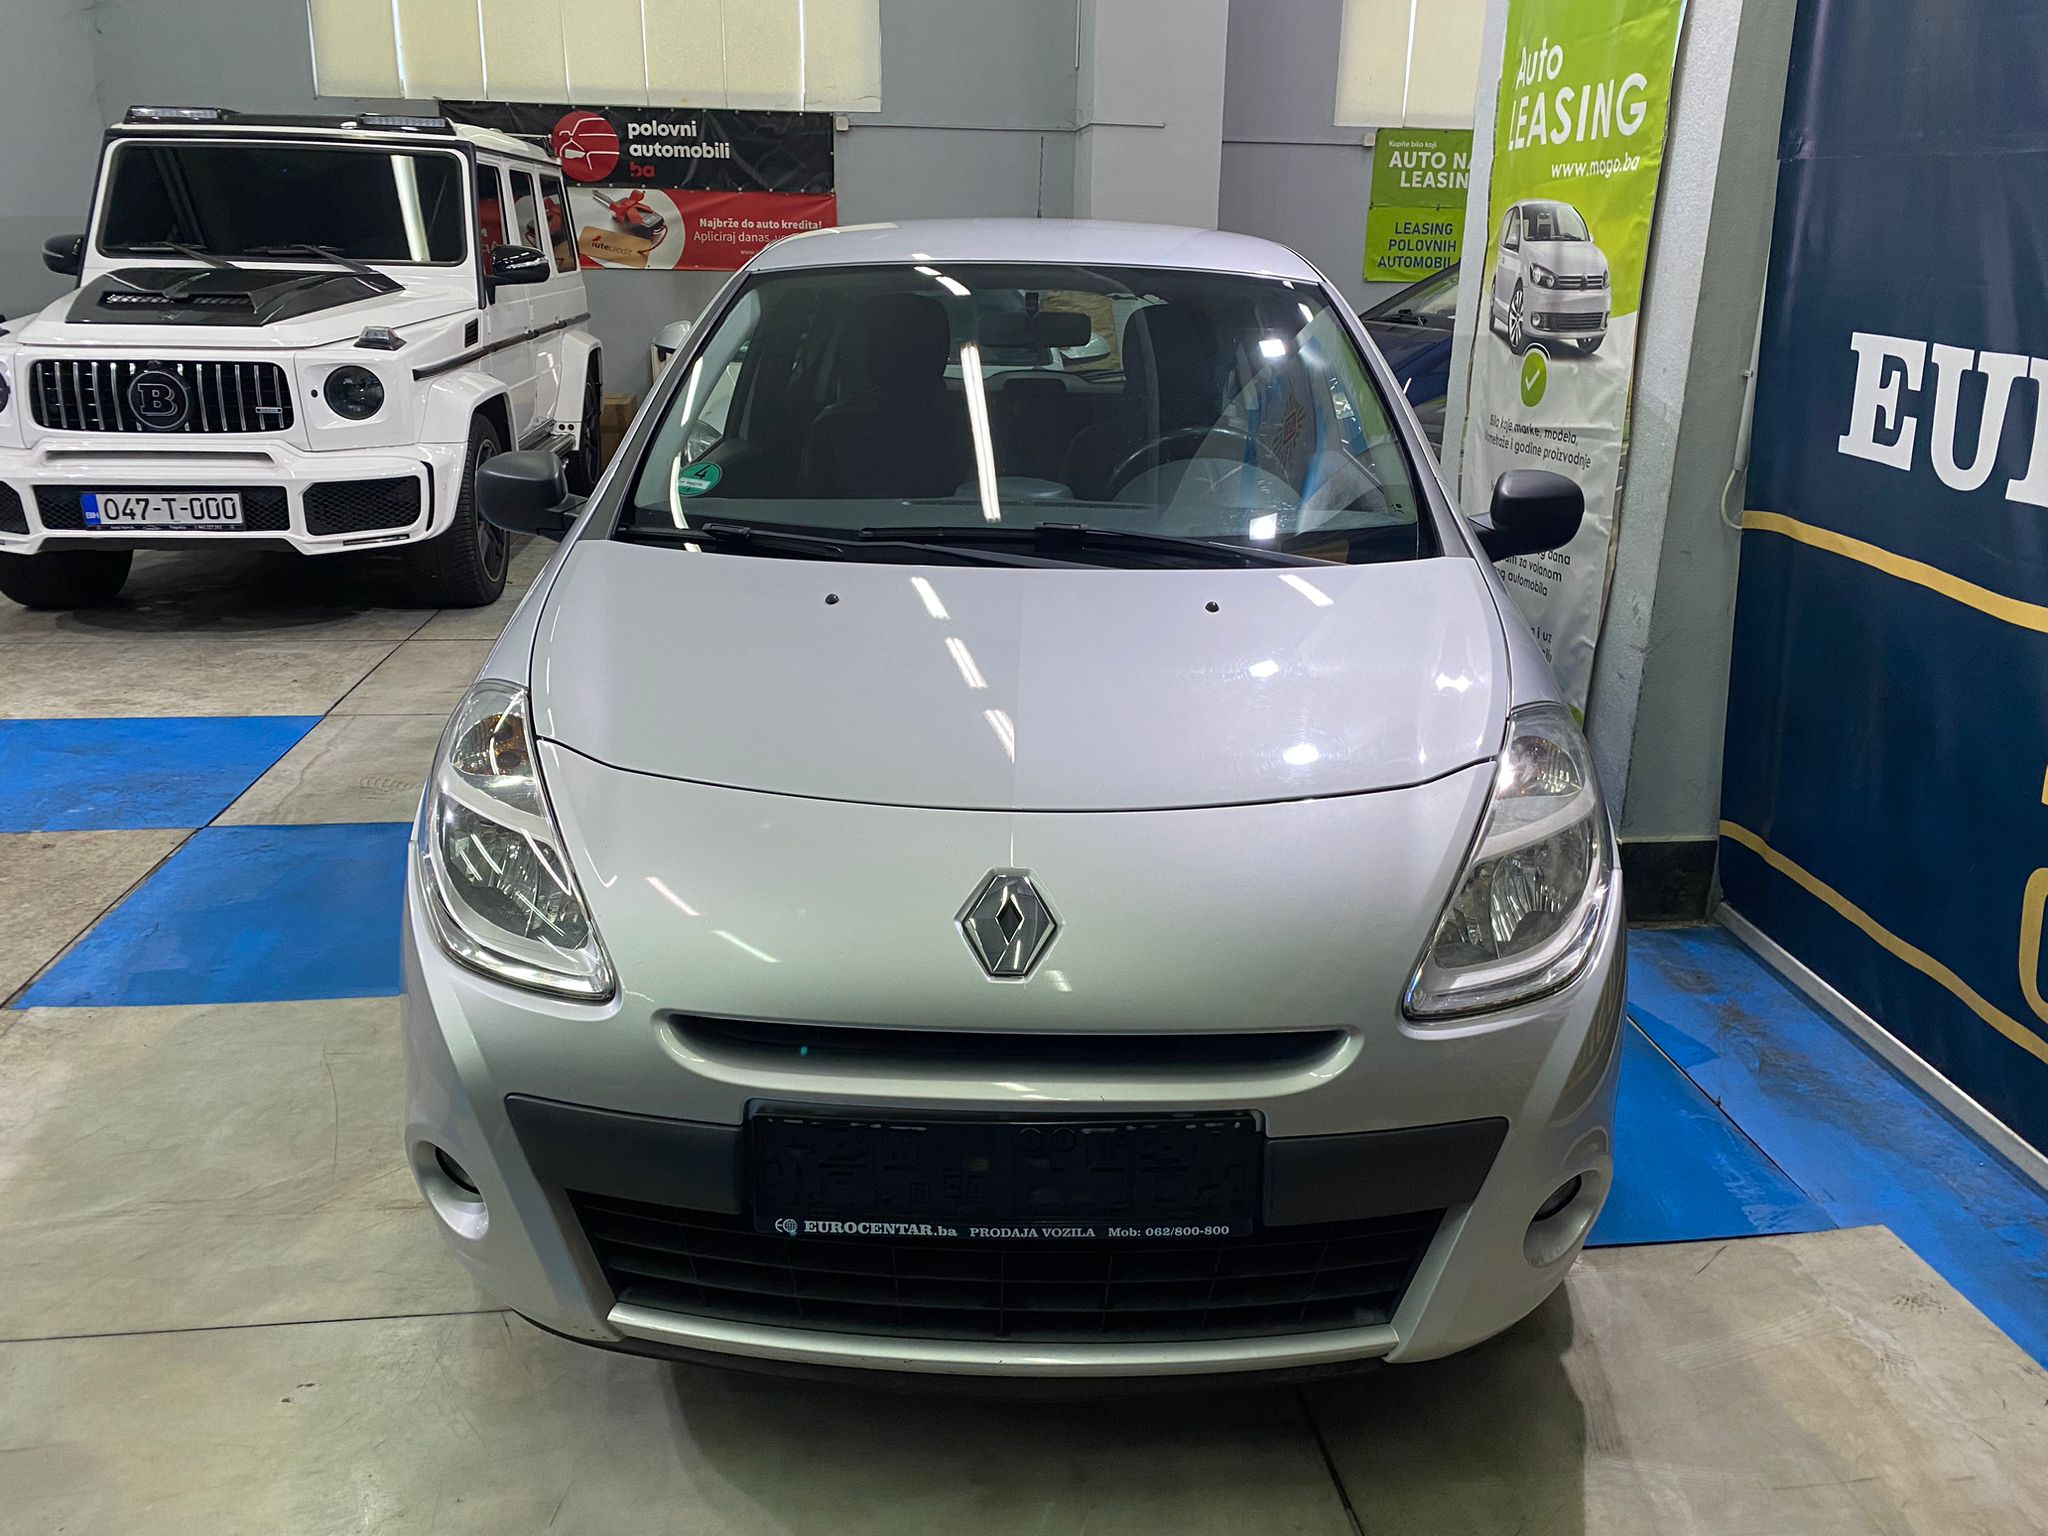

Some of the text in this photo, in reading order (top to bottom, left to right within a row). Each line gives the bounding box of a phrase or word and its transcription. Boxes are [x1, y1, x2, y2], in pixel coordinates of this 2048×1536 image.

[1515, 37, 1563, 90] Auto
[1508, 72, 1648, 151] LEASING
[627, 120, 697, 139] polovni
[629, 142, 730, 159] automobili
[1389, 140, 1437, 149] Kupite bilo koji
[1389, 151, 1471, 169] AUTO N
[1551, 152, 1640, 179] www.mogo.ba
[700, 218, 822, 230] Najbrže do auto kredita!
[1395, 222, 1453, 235] LEASING
[693, 231, 736, 244] Apliciraj
[1389, 239, 1456, 252] POLOVNIH
[137, 383, 178, 416] B
[1514, 423, 1542, 438] marke,
[1545, 428, 1578, 446] modela,
[1514, 441, 1542, 456] godine
[1543, 447, 1591, 470] proizvodnje
[694, 464, 711, 480] 4
[103, 497, 237, 520] 047-T-000
[1519, 557, 1527, 568] za
[1529, 560, 1562, 582] volanom
[1508, 572, 1548, 596] automobila
[1542, 631, 1552, 643] uz
[803, 1220, 958, 1237] EUROCENTAR.ba
[969, 1227, 1038, 1238] PRODAJA
[1042, 1227, 1096, 1238] VOZILA
[1108, 1227, 1141, 1238] Mob:
[1145, 1225, 1230, 1238] 062/800-800
